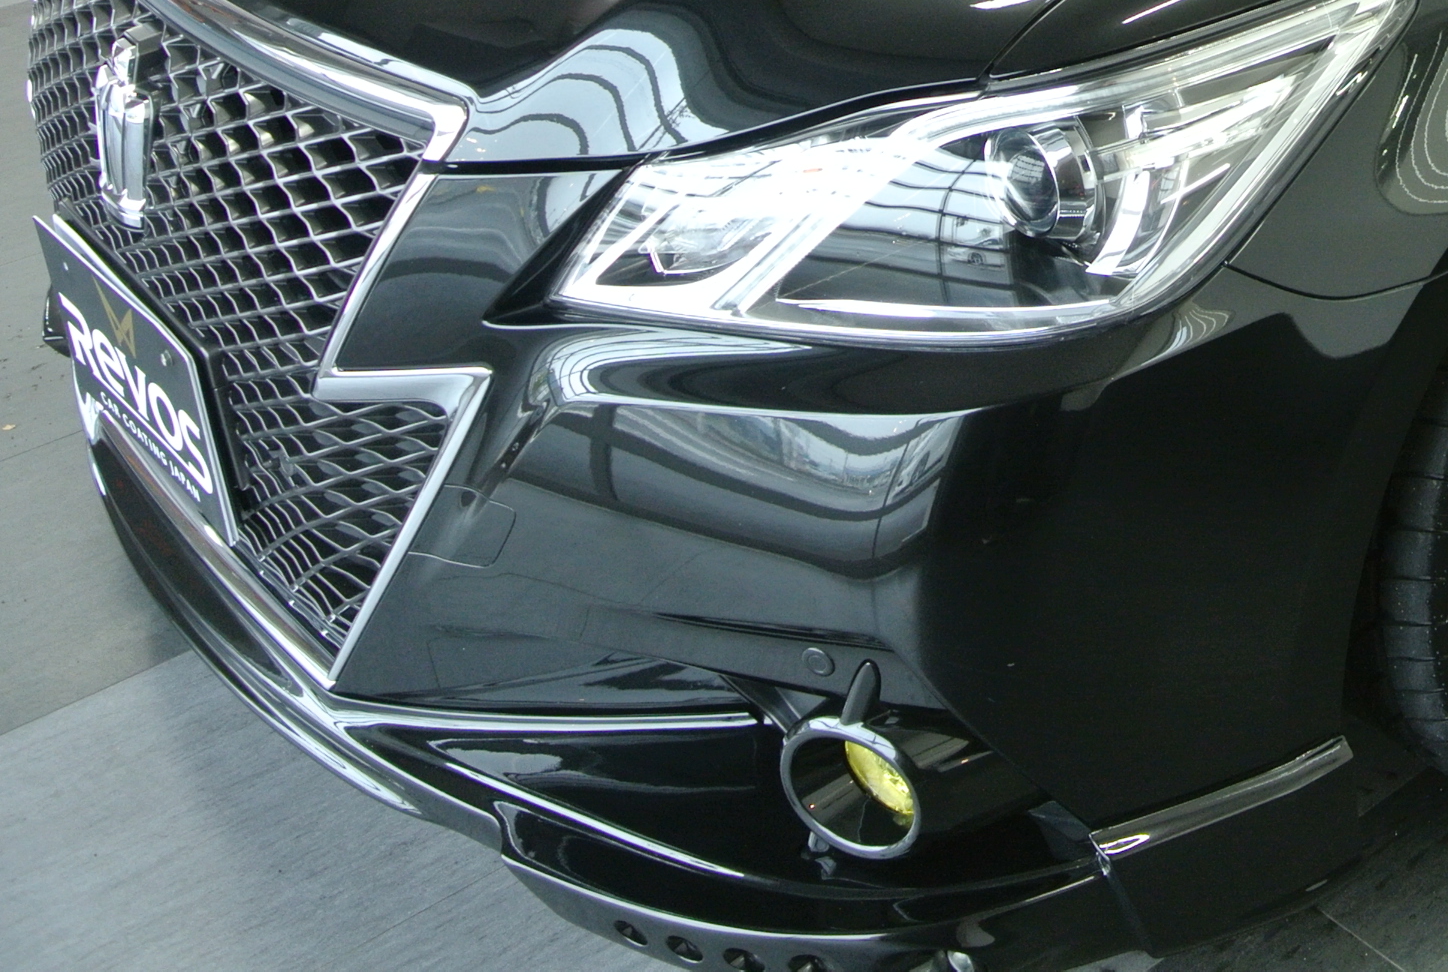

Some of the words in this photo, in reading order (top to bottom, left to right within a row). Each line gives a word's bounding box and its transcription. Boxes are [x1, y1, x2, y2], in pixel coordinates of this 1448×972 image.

[100, 391, 121, 419] CAR
[122, 413, 168, 466] COATING
[168, 460, 202, 503] JAPAN
